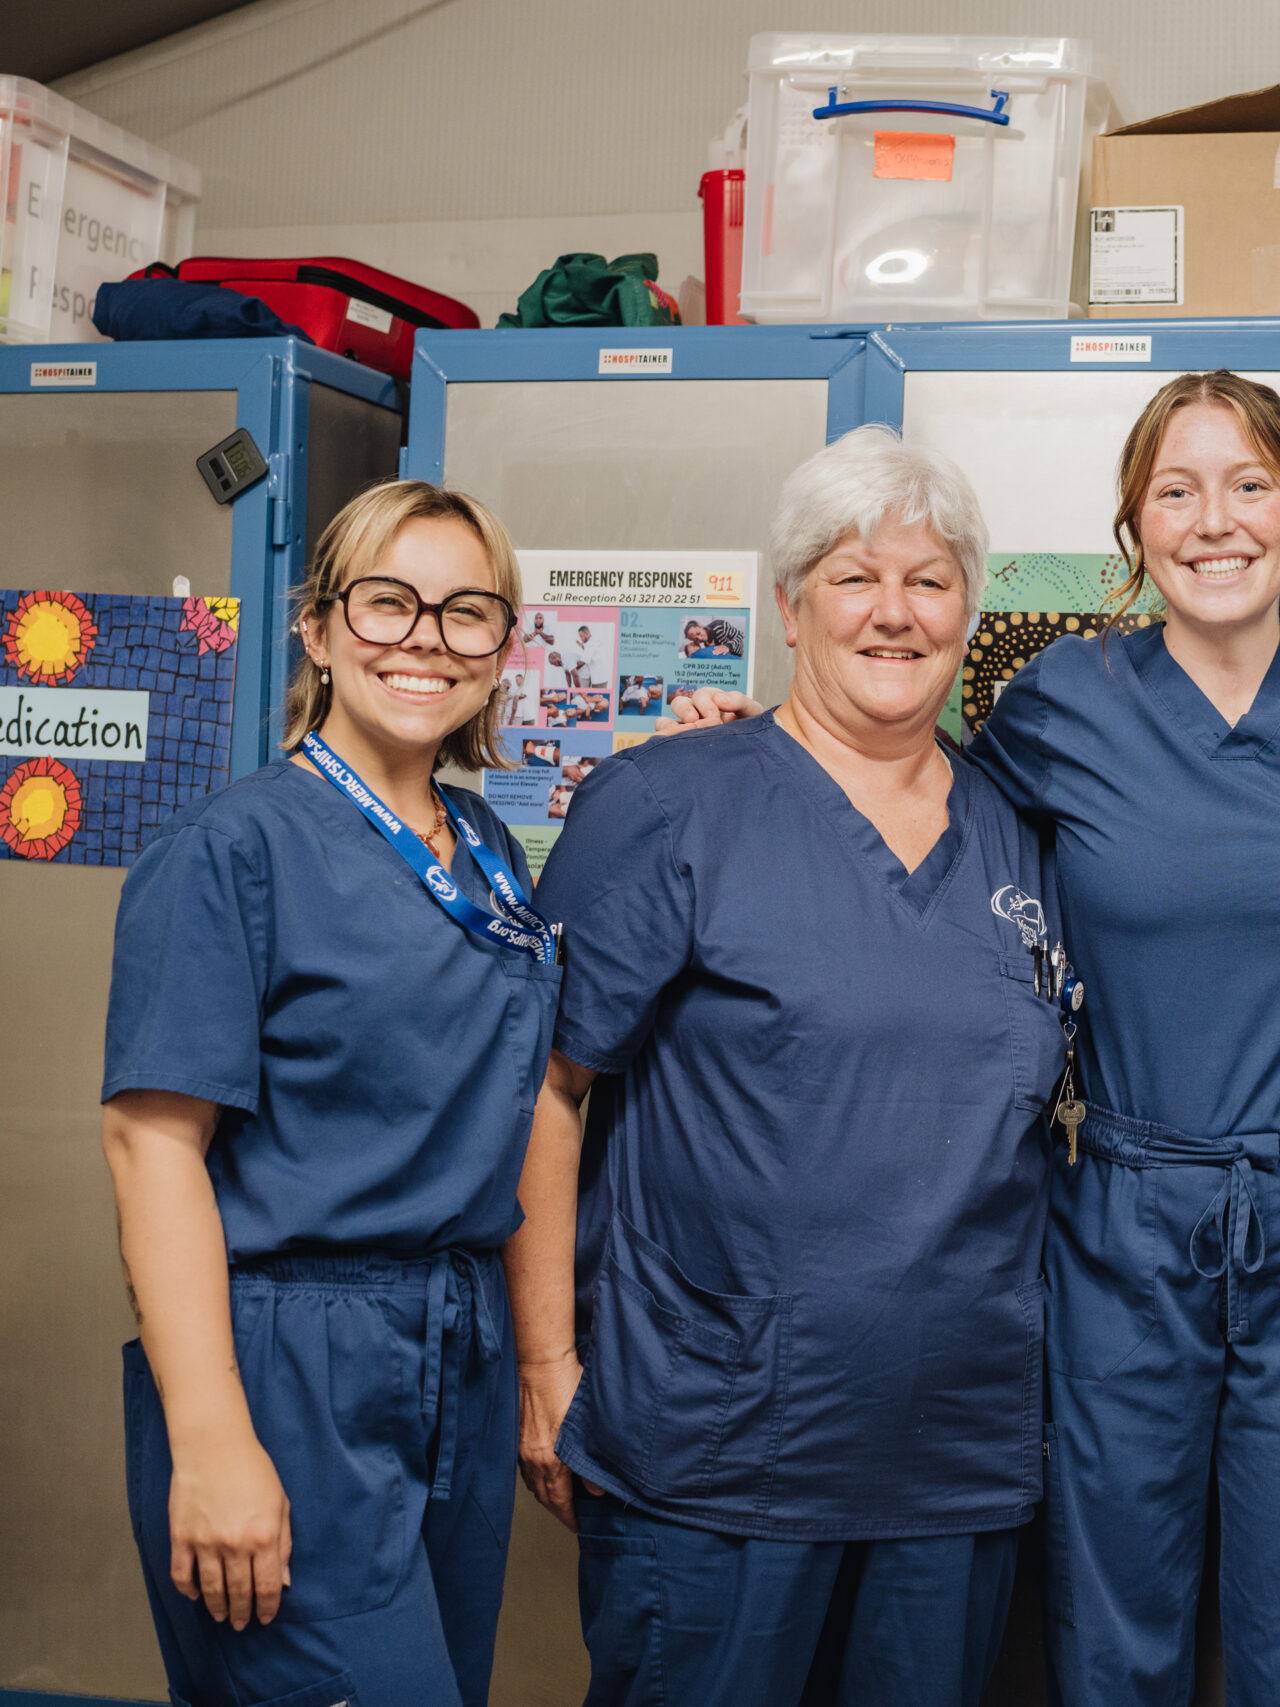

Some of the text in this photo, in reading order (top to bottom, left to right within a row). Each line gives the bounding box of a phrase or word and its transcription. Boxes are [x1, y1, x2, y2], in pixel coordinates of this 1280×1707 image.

[27, 181, 147, 264] Eergenc
[1085, 342, 1147, 352] HOSPITAINER
[612, 354, 668, 364] HOSPITAINER
[42, 367, 93, 377] HOSPITAINER
[549, 570, 693, 589] EMERGENCY RESPONSE
[708, 575, 734, 592] 911
[542, 592, 701, 604] Call Reception 261 321 20 22 51
[632, 632, 660, 640] Breathing
[710, 663, 732, 671] (Adult)
